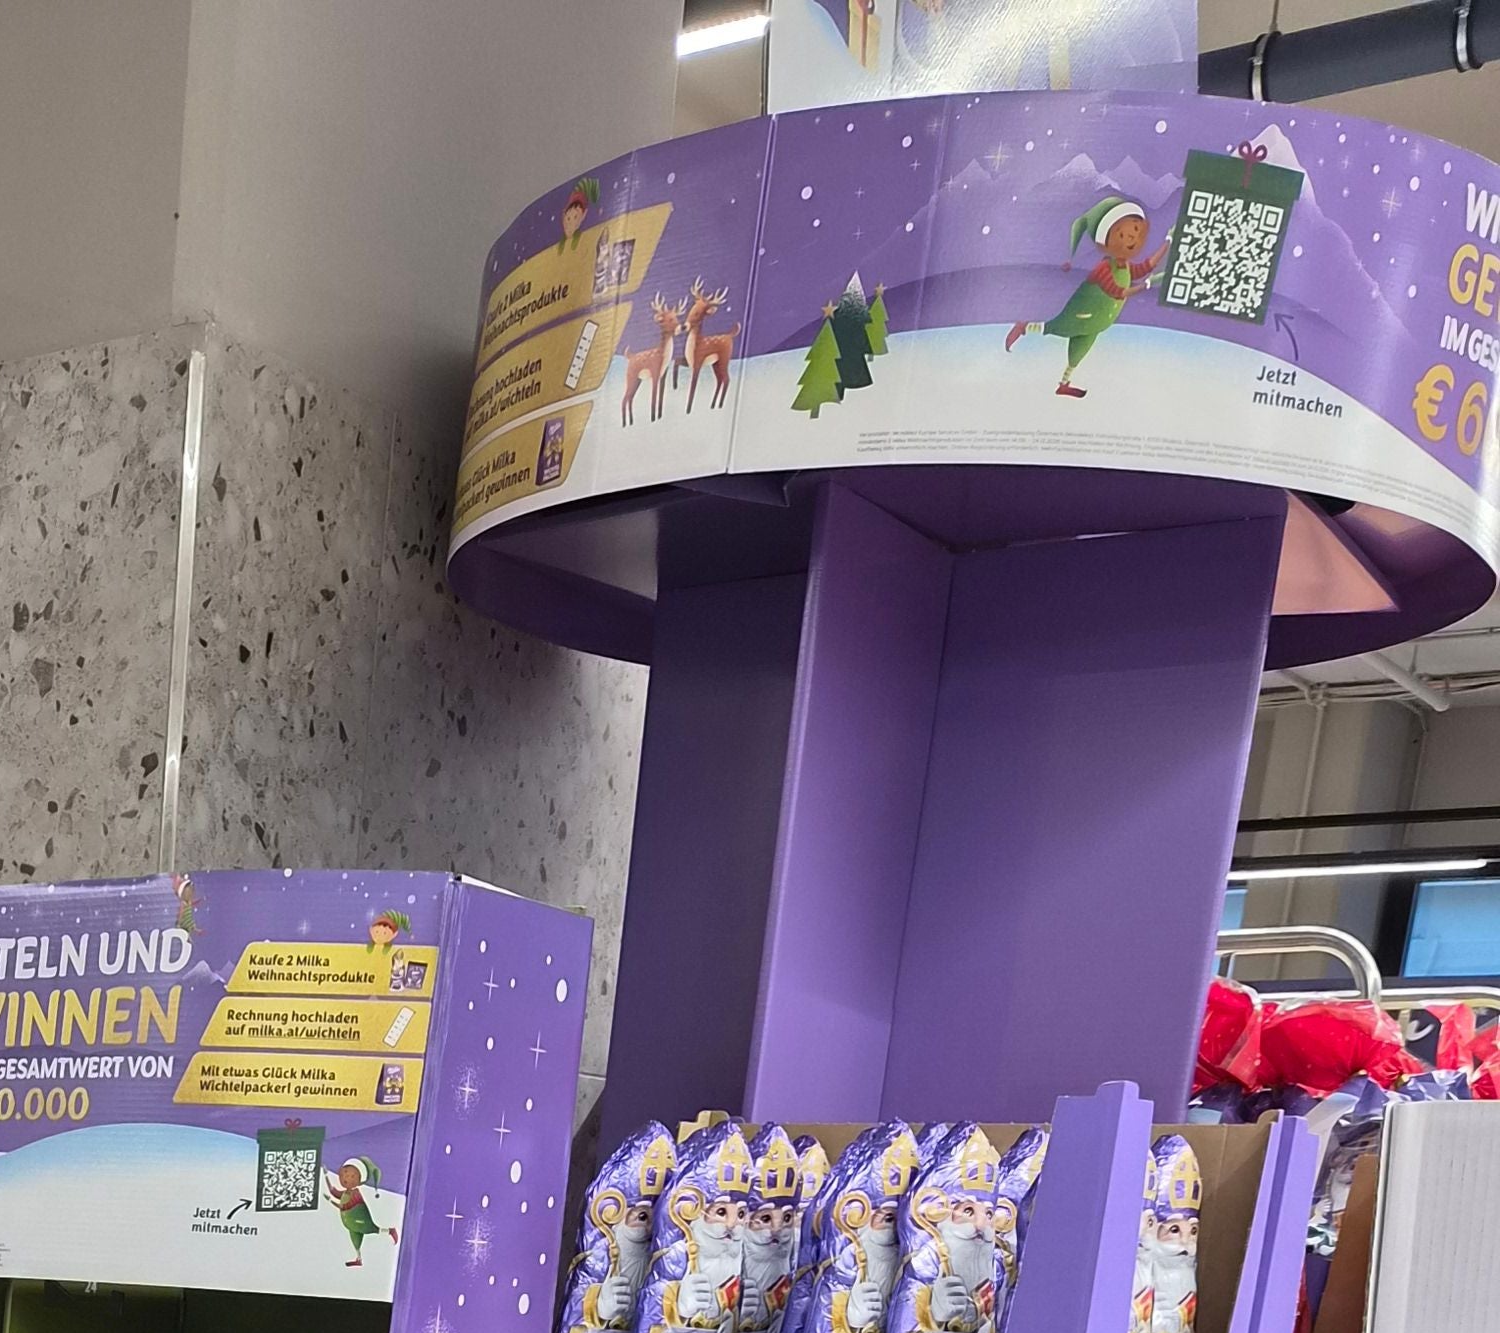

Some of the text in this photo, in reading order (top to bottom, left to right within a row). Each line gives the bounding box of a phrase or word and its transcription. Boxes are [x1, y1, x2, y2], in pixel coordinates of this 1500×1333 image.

[1449, 243, 1500, 317] GE
[1440, 315, 1469, 356] IM
[1256, 365, 1297, 386] Jetzt
[1252, 389, 1343, 418] mitmachen
[99, 927, 192, 974] UND
[250, 954, 330, 967] Kaufe 2 Milka
[248, 969, 375, 985] Weihnachtsprodukte
[227, 1009, 359, 1025] Rechnung hochladen
[225, 1024, 361, 1040] auf milka.at/wichteln
[128, 1056, 174, 1079] VON
[201, 1065, 336, 1081] Mit etwas Glück Milka
[200, 1080, 358, 1098] Wichtelpackerl gewinnen
[193, 1207, 221, 1219] Jetzt
[192, 1222, 258, 1236] mitmachen
